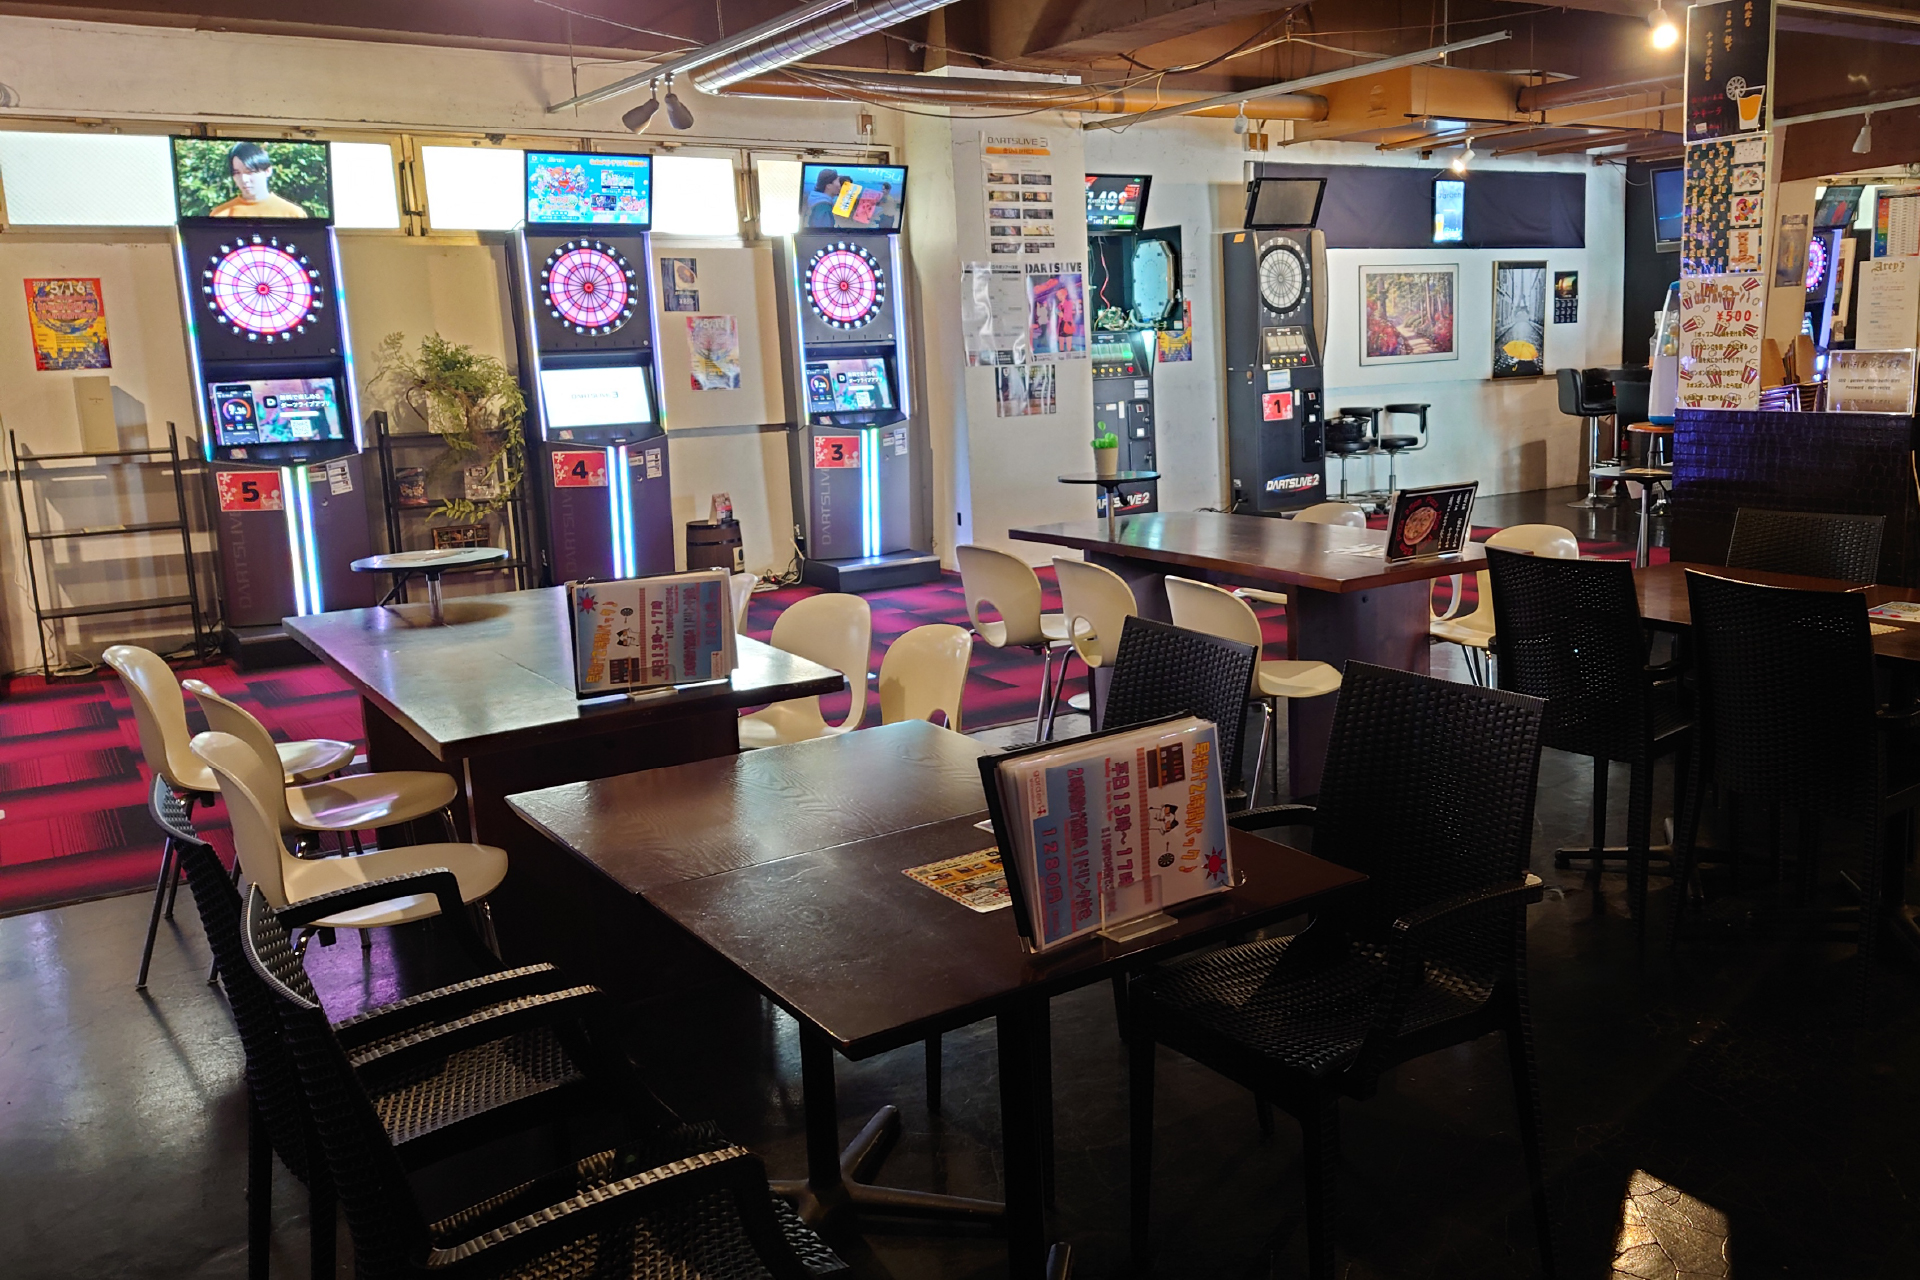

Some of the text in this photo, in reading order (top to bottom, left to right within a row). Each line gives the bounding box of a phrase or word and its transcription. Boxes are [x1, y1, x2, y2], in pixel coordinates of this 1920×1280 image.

[988, 136, 1049, 148] DARTSLIVE 3
[1026, 262, 1082, 273] DARTSLIVE
[50, 281, 85, 294] 5/16
[279, 393, 321, 401] 無料で楽しめる
[280, 400, 331, 408] ダーツライブアプリ
[1274, 399, 1282, 414] 1
[831, 444, 844, 461] 3
[571, 460, 588, 479] 4
[1265, 474, 1320, 491] DARTSLIVE2
[241, 481, 260, 502] 5
[821, 468, 832, 545] DARTSLIV
[1111, 761, 1135, 888] 平日13時~17時
[1042, 826, 1063, 904] 1280円
